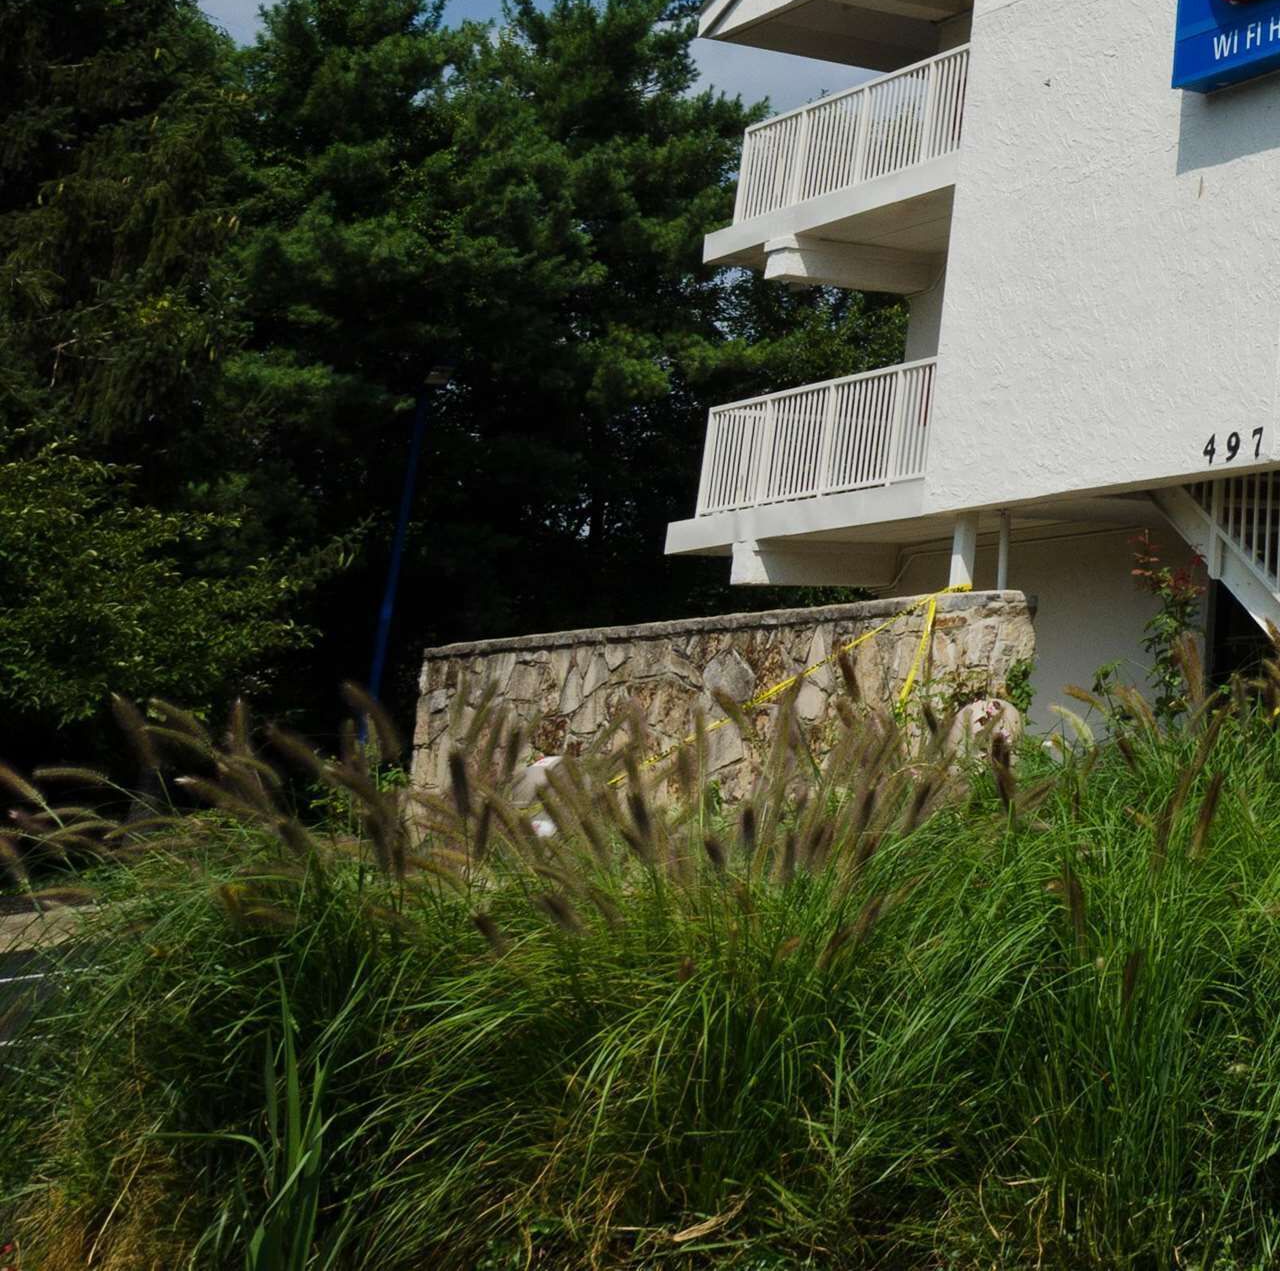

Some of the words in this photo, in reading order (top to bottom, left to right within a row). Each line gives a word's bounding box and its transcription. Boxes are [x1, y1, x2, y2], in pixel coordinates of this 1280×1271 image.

[1213, 30, 1238, 60] WI
[1246, 21, 1261, 50] FI
[1203, 426, 1264, 465] 497
